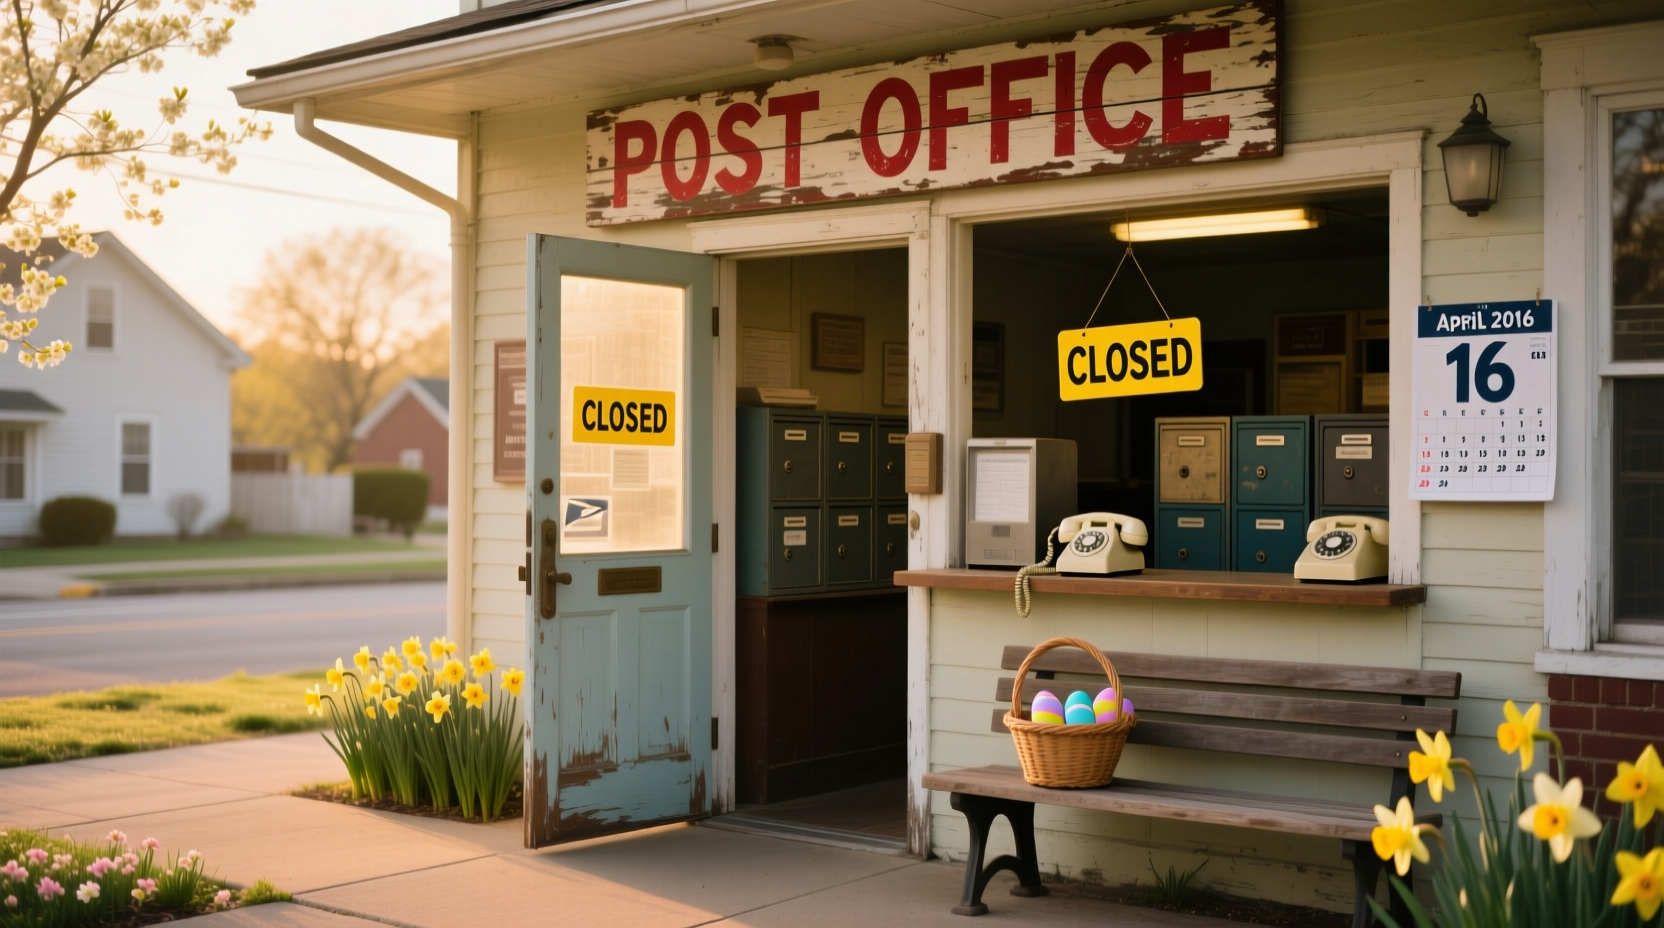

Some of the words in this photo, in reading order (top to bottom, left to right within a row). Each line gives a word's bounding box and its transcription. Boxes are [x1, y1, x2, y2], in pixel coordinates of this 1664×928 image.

[612, 90, 820, 208] POST
[860, 26, 1231, 178] OFFICE
[1491, 309, 1535, 329] 2016
[1067, 336, 1193, 386] CLOSED
[1446, 341, 1516, 404] 16
[581, 399, 668, 434] CLOSED
